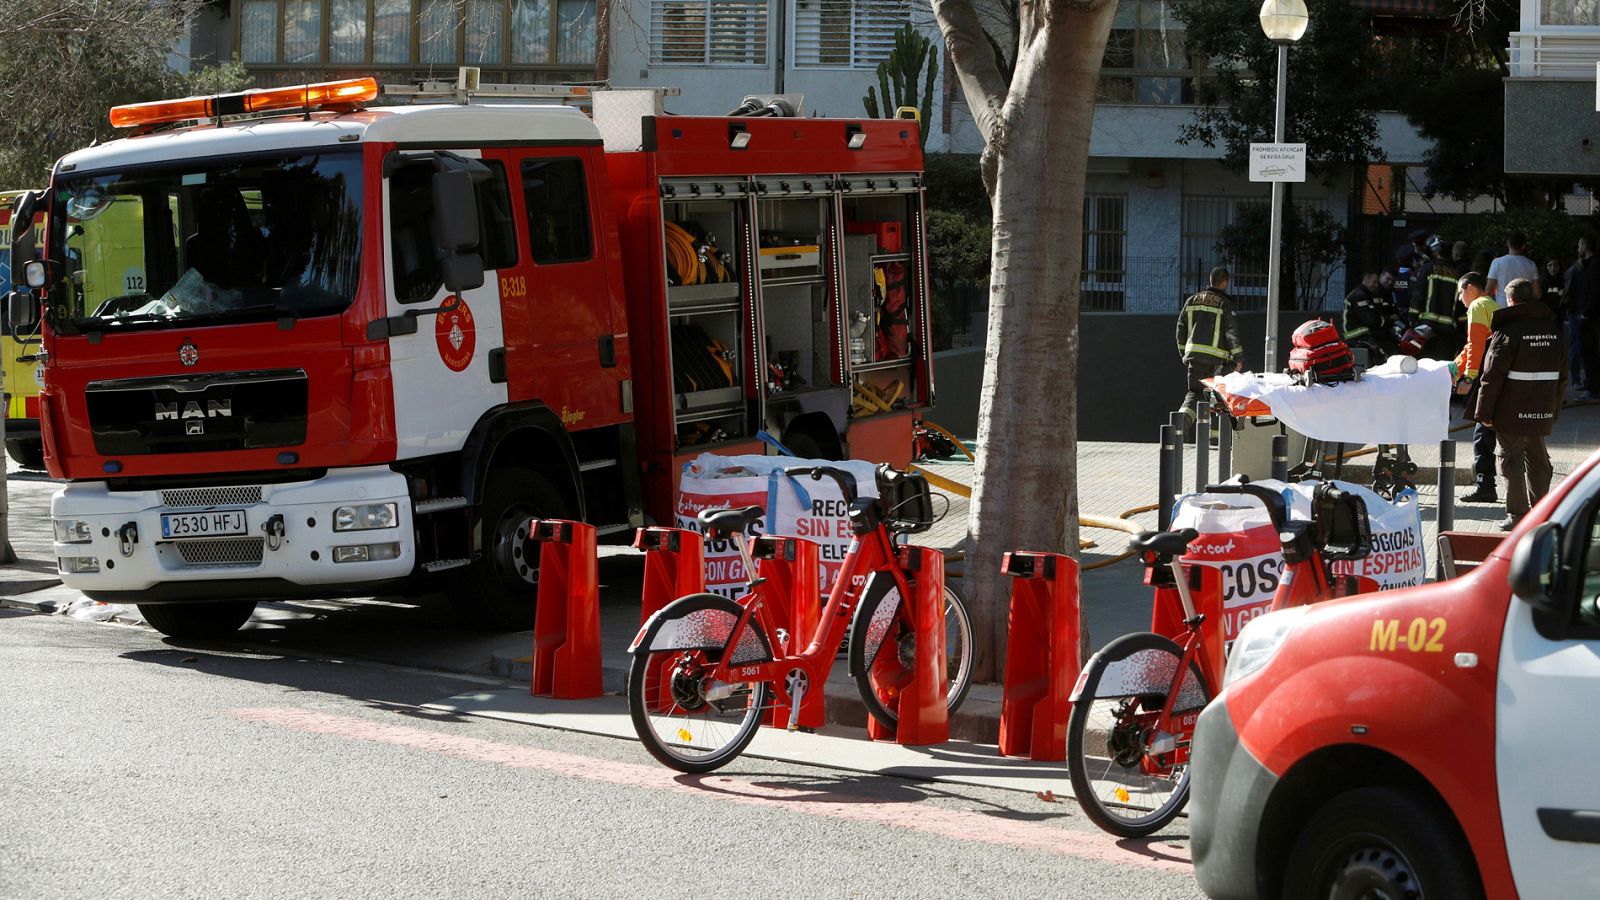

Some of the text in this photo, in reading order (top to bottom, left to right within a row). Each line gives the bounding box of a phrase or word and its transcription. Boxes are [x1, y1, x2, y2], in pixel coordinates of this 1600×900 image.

[126, 276, 144, 290] 112
[501, 276, 527, 298] B-318
[36, 369, 44, 378] 11
[155, 399, 232, 420] MAN
[172, 513, 241, 534] 2530 HFJ
[796, 518, 829, 537] SIN
[1362, 546, 1421, 576] ESPERAS
[1369, 617, 1447, 652] M-02
[742, 666, 760, 677] 5061
